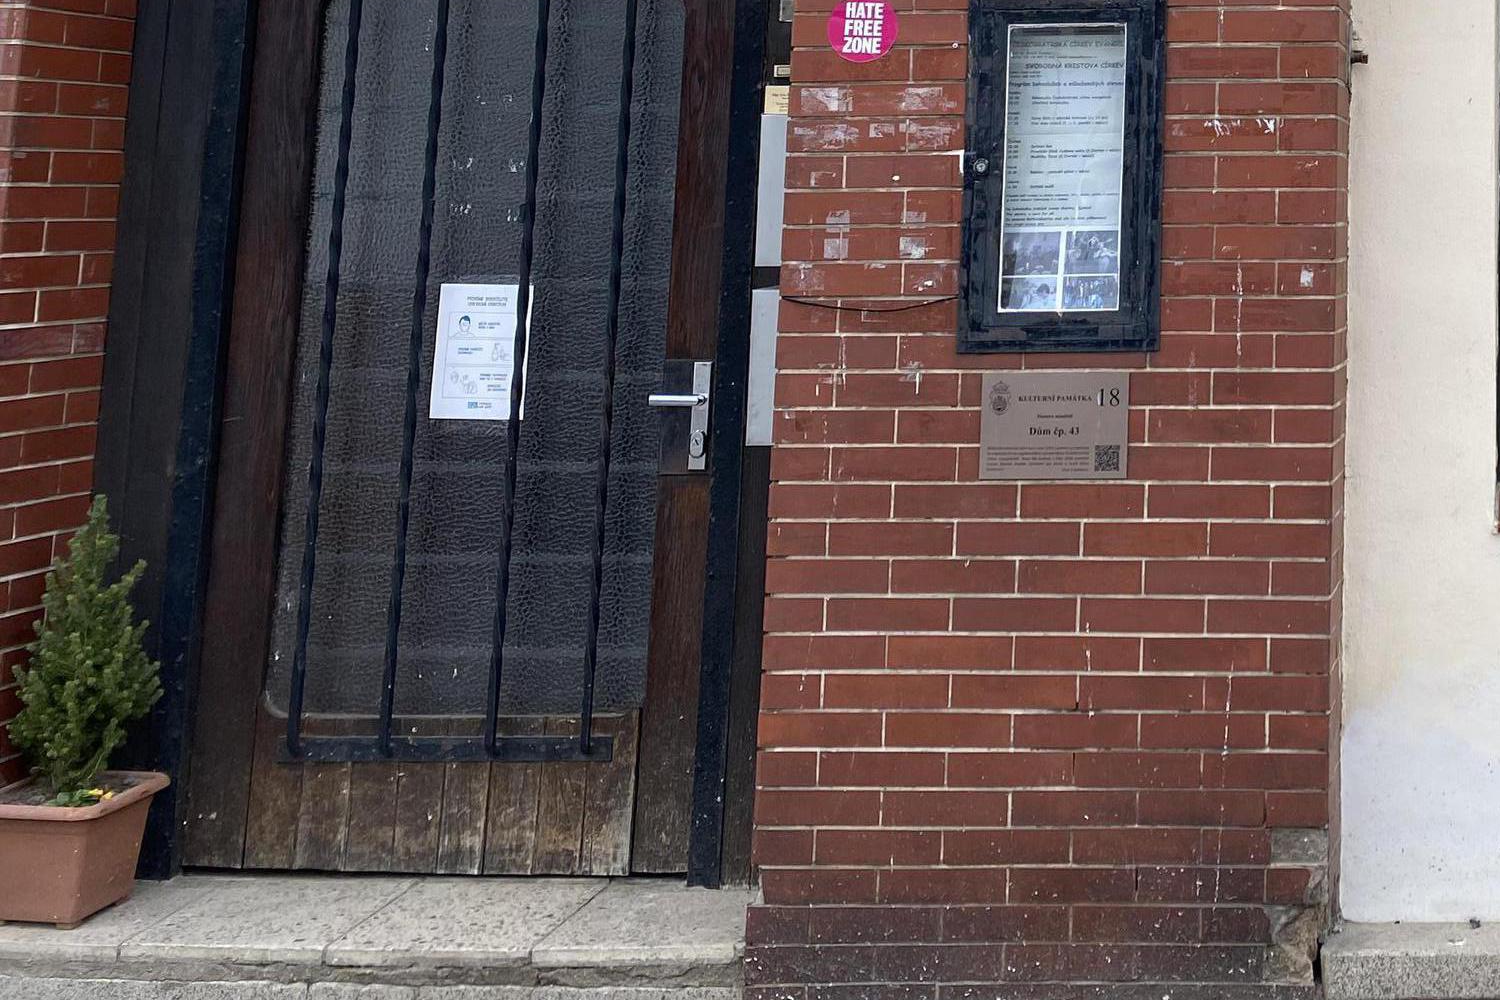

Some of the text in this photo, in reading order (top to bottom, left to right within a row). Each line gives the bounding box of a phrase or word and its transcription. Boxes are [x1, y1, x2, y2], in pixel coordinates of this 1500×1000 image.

[845, 1, 885, 19] HATE
[843, 18, 884, 37] FREE
[841, 36, 882, 54] ZONE
[1100, 388, 1120, 407] 18
[1029, 426, 1080, 437] Dům čp. 43
